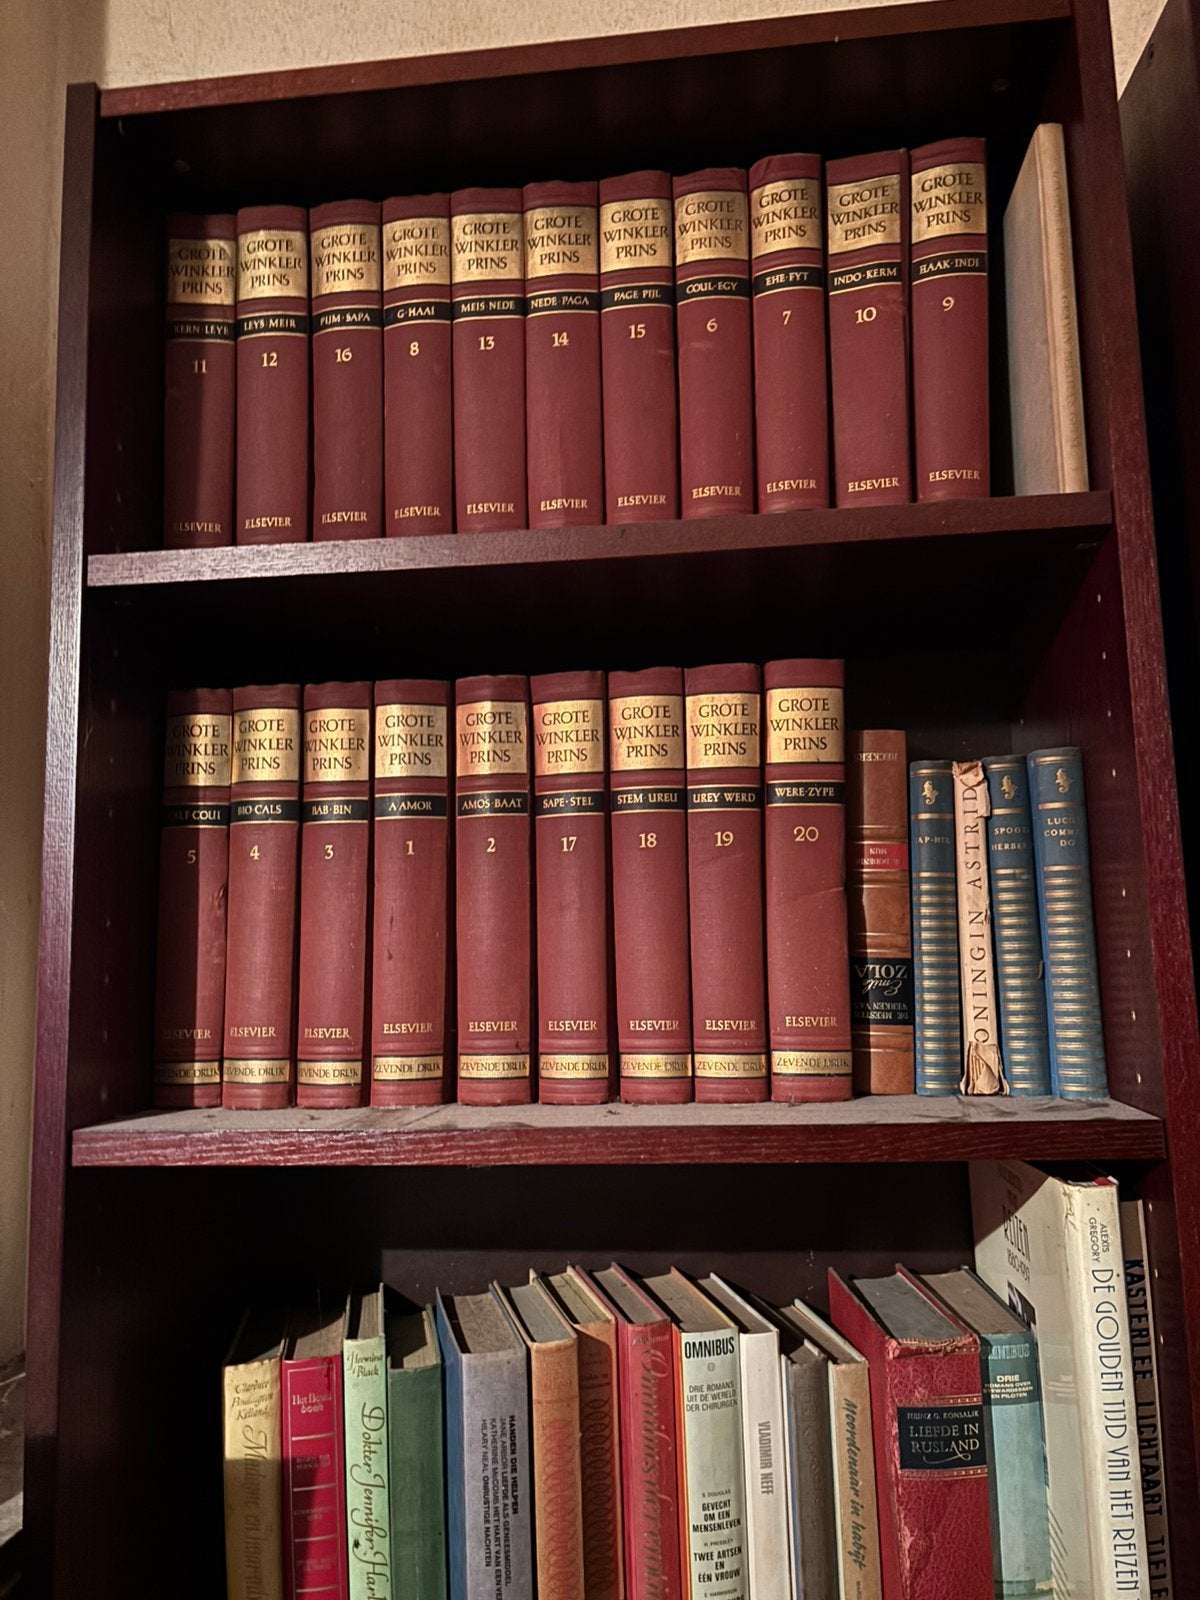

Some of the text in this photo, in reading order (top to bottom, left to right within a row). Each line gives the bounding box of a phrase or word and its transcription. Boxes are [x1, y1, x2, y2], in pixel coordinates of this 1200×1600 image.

[922, 172, 973, 192] GROTE
[760, 188, 808, 208] GROTE
[840, 186, 889, 206] GROTE
[914, 191, 983, 213] WINKLER
[685, 200, 734, 215] GROTE
[831, 203, 899, 225] WINKLER
[611, 207, 659, 223] GROTE
[753, 206, 818, 229] WINKLER
[927, 210, 970, 228] PRINS
[463, 222, 510, 235] GROTE
[534, 216, 581, 230] GROTE
[679, 219, 743, 236] WINKLER
[393, 227, 439, 242] GROTE
[604, 227, 668, 243] WINKLER
[765, 225, 806, 243] PRINS
[845, 222, 886, 241] PRINS
[247, 240, 293, 253] GROTE
[321, 233, 366, 249] GROTE
[455, 240, 519, 254] WINKLER
[528, 234, 591, 249] WINKLER
[691, 236, 731, 250] PRINS
[178, 249, 229, 261] GROTE
[387, 243, 447, 261] WINKLER
[540, 251, 580, 264] PRINS
[616, 244, 656, 258] PRINS
[240, 257, 301, 272] WINKLER
[315, 250, 376, 268] WINKLER
[468, 257, 507, 270] PRINS
[171, 266, 235, 278] WINKLER
[326, 268, 364, 282] PRINS
[398, 262, 436, 276] PRINS
[251, 273, 290, 288] PRINS
[182, 283, 222, 294] PRINS
[942, 296, 954, 311] 9
[783, 311, 791, 325] 7
[856, 307, 877, 323] 10
[629, 324, 645, 339] 15
[707, 318, 717, 332] 6
[479, 336, 494, 350] 13
[553, 332, 568, 346] 14
[336, 349, 352, 362] 16
[410, 342, 419, 356] 8
[194, 360, 206, 373] 11
[262, 353, 277, 366] 12
[692, 486, 740, 499] ELSEVIER
[618, 495, 666, 507] ELSEVIER
[699, 704, 749, 717] GROTE
[778, 698, 830, 712] GROTE
[466, 712, 513, 726] GROTE
[542, 710, 589, 726] GROTE
[622, 705, 671, 720] GROTE
[239, 719, 284, 732] GROTE
[310, 719, 355, 733] GROTE
[386, 715, 434, 728] GROTE
[771, 717, 839, 731] WINKLER
[536, 729, 599, 746] WINKLER
[615, 725, 679, 741] WINKLER
[691, 723, 757, 738] WINKLER
[234, 738, 292, 751] WINKLER
[378, 733, 443, 748] WINKLER
[460, 730, 522, 746] WINKLER
[784, 737, 827, 750] PRINS
[305, 739, 364, 752] WINKLER
[626, 744, 668, 758] PRINS
[704, 742, 746, 755] PRINS
[390, 752, 431, 765] PRINS
[470, 750, 510, 763] PRINS
[547, 749, 587, 763] PRINS
[241, 757, 280, 770] PRINS
[313, 757, 352, 770] PRINS
[639, 833, 656, 848] 18
[715, 831, 733, 846] 19
[794, 826, 818, 841] 20
[407, 841, 414, 855] 1
[487, 838, 496, 853] 2
[561, 837, 577, 852] 17
[187, 850, 196, 863] 5
[250, 845, 259, 859] 4
[325, 845, 333, 859] 3
[962, 776, 989, 1045] ONINGIN ASTRID
[855, 964, 908, 978] ZOLA
[1088, 1217, 1101, 1263] GREGORY
[1100, 1223, 1110, 1253] ALEXIS
[685, 1336, 734, 1359] OMNIBUS
[980, 1344, 1030, 1360] OMNIBUS
[689, 1381, 734, 1393] DRIE ROMANS
[1125, 1259, 1163, 1517] KASTERLEE LICHTAART
[686, 1390, 736, 1402] UIT DE WERELD
[686, 1400, 737, 1412] DER CHIRURGEN
[481, 1419, 489, 1449] HILARY
[910, 1424, 979, 1438] LIEFDE IN
[1092, 1269, 1140, 1591] DE GOUDEN TIJD VAN HET REIZEN
[490, 1418, 498, 1465] KATHERINE
[842, 1398, 861, 1497] Moordenaar
[912, 1439, 980, 1453] RUSLAND
[757, 1420, 774, 1495] VLADIMIR NEFF
[350, 1402, 388, 1551] Dokter Jennifer
[501, 1471, 509, 1500] LIEFDE
[708, 1489, 731, 1497] DOUGLAS
[483, 1476, 491, 1525] ONRUSTIGE
[702, 1499, 731, 1511] GEVECHT
[850, 1500, 865, 1516] in
[704, 1510, 730, 1522] OM EEN
[693, 1518, 741, 1532] MENSENLEVEN
[493, 1525, 501, 1547] HART
[484, 1527, 492, 1566] NACHTEN
[503, 1521, 511, 1586] GENEESMIDDEL
[694, 1546, 742, 1561] TWEE ARTSEN
[715, 1561, 724, 1570] EN
[698, 1568, 740, 1582] ÉÉN VROUW
